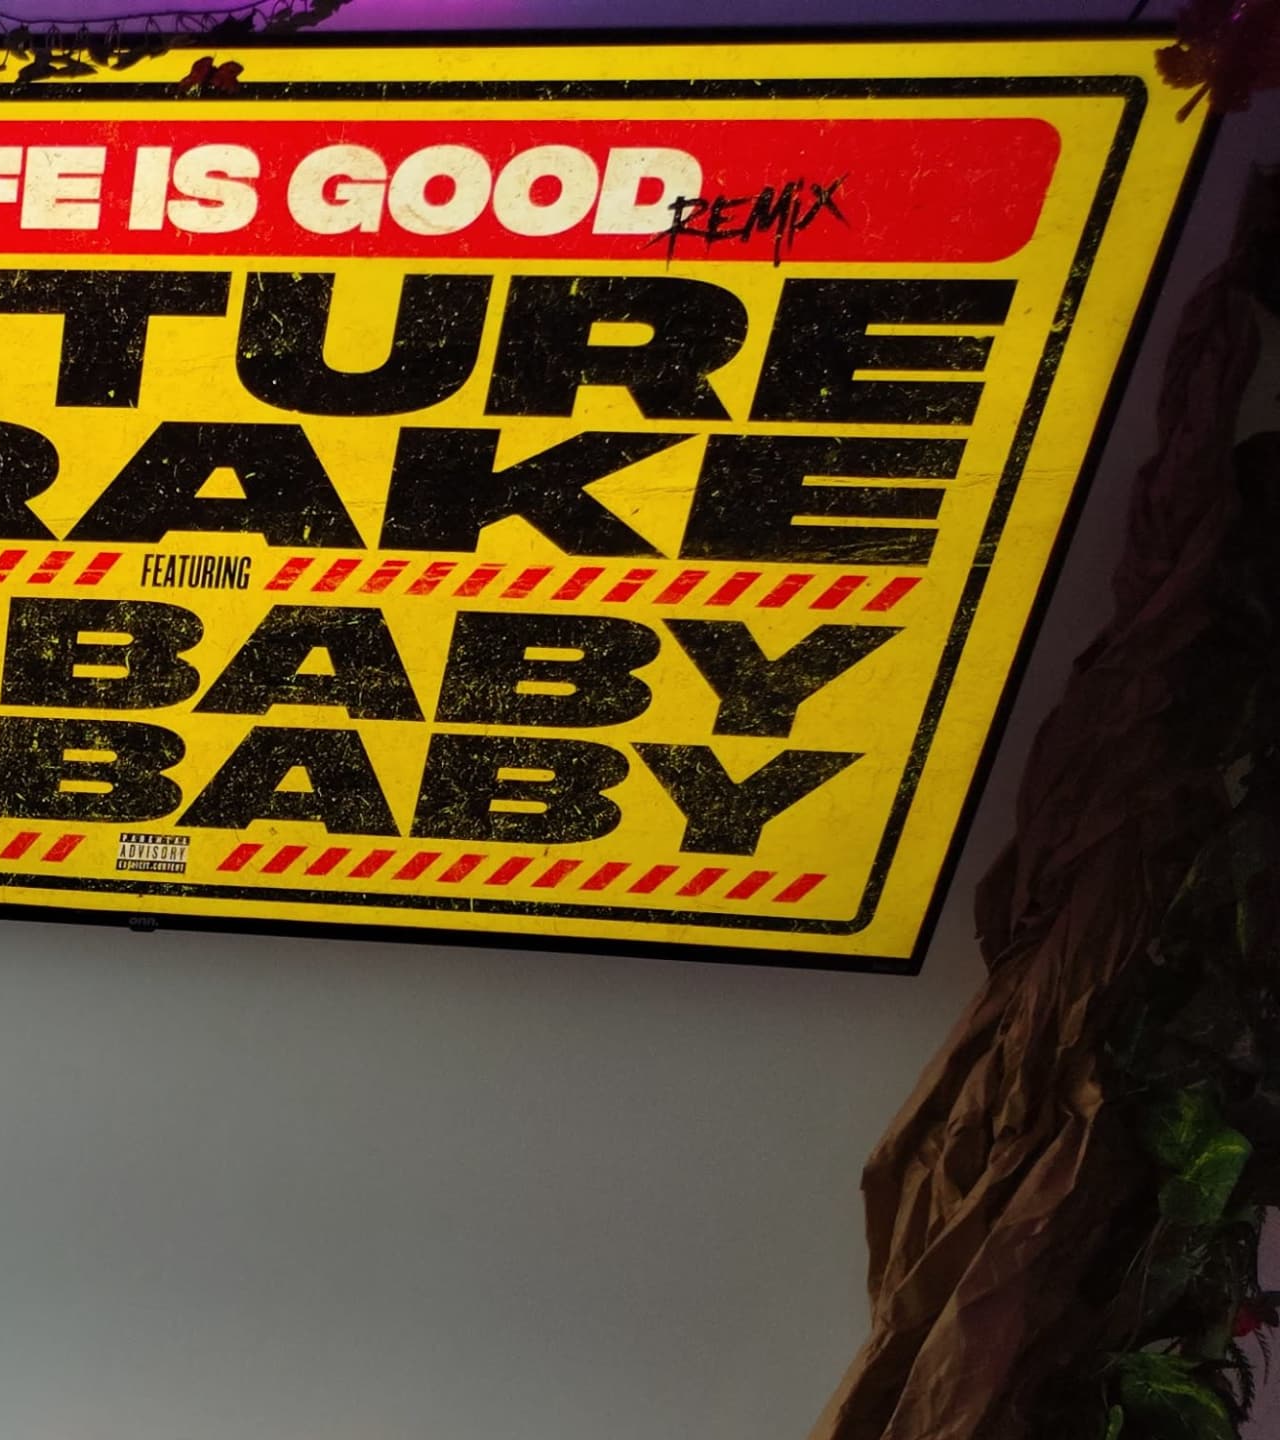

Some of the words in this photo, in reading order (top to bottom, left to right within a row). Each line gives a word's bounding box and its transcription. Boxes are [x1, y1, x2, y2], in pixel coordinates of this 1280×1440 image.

[128, 145, 260, 233] IS
[286, 145, 704, 236] GOOD
[141, 553, 252, 590] FEATURING
[120, 844, 186, 861] ADVISORY
